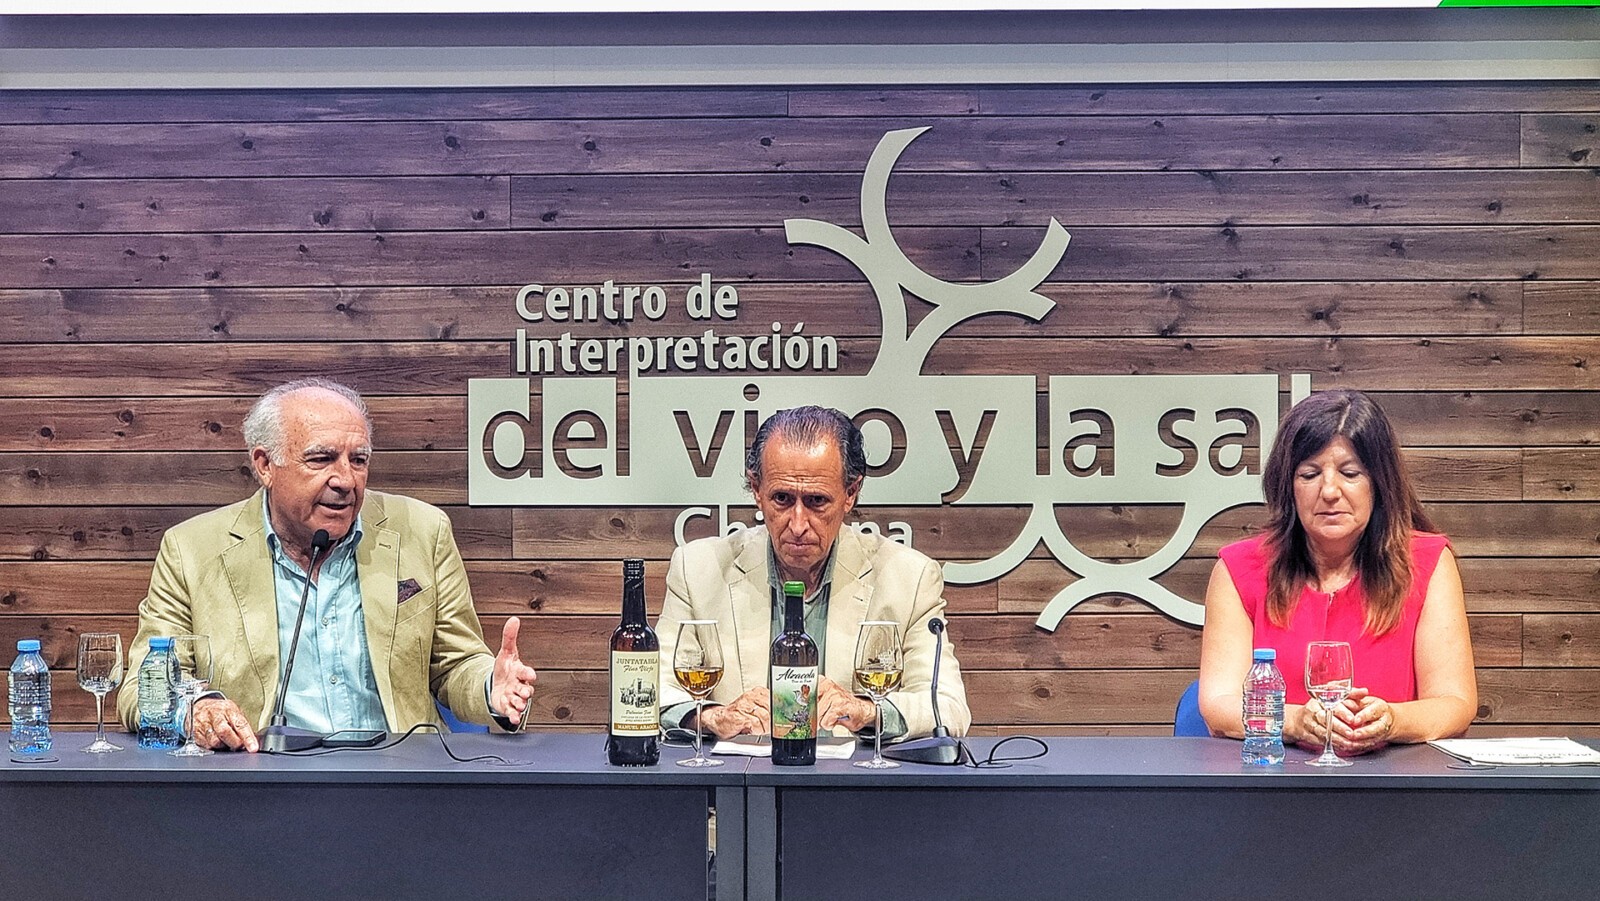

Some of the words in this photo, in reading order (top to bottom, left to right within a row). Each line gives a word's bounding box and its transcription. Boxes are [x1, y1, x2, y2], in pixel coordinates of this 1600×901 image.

[516, 280, 667, 320] Centro
[686, 273, 738, 319] de
[516, 322, 838, 376] Interpretación
[482, 377, 630, 479] del
[673, 383, 907, 478] vio
[935, 410, 998, 503] y
[1036, 375, 1115, 477] la
[623, 665, 638, 673] Fino
